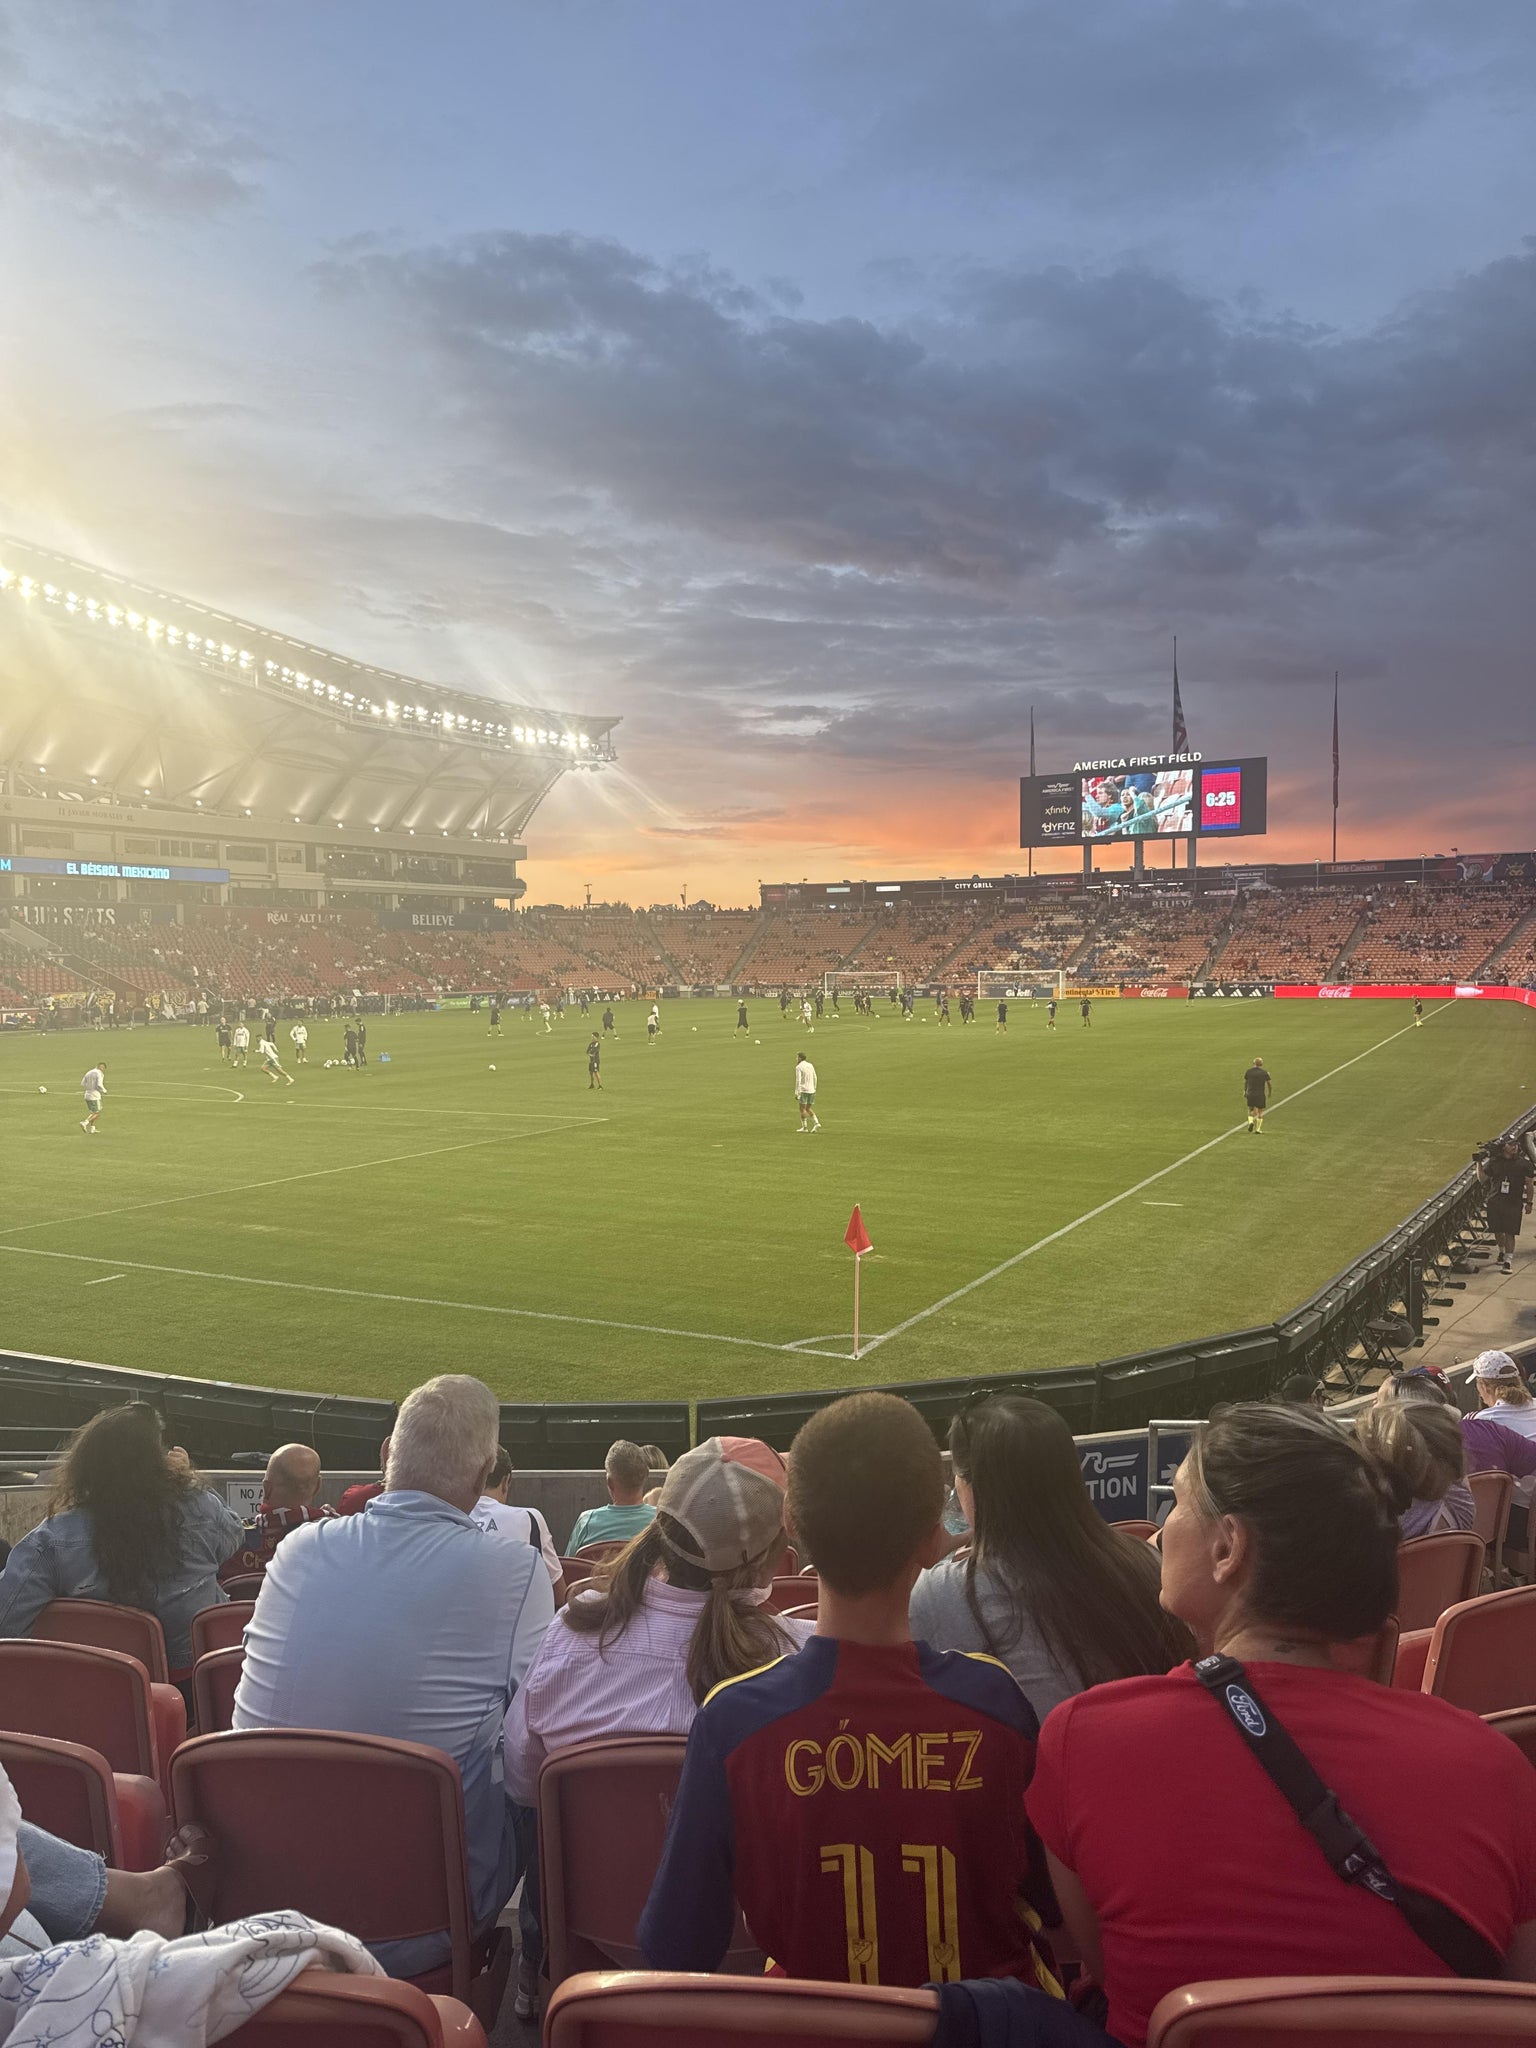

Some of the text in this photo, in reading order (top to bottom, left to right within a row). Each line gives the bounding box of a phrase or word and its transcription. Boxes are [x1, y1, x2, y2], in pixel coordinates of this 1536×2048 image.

[1073, 752, 1202, 772] AMERICA FIRST FIELD
[1206, 791, 1236, 807] 6:25
[1045, 806, 1072, 815] xfinity
[66, 862, 79, 875] EL
[122, 866, 169, 880] MEXICANO
[972, 881, 993, 889] GRILL
[294, 913, 316, 923] ALT
[412, 914, 455, 926] BELIEVE
[240, 1489, 254, 1499] NO
[1085, 1475, 1137, 1500] TION
[1231, 1692, 1260, 1728] Ford
[785, 1718, 983, 1796] GÓMEZ
[820, 1843, 962, 1987] 11
